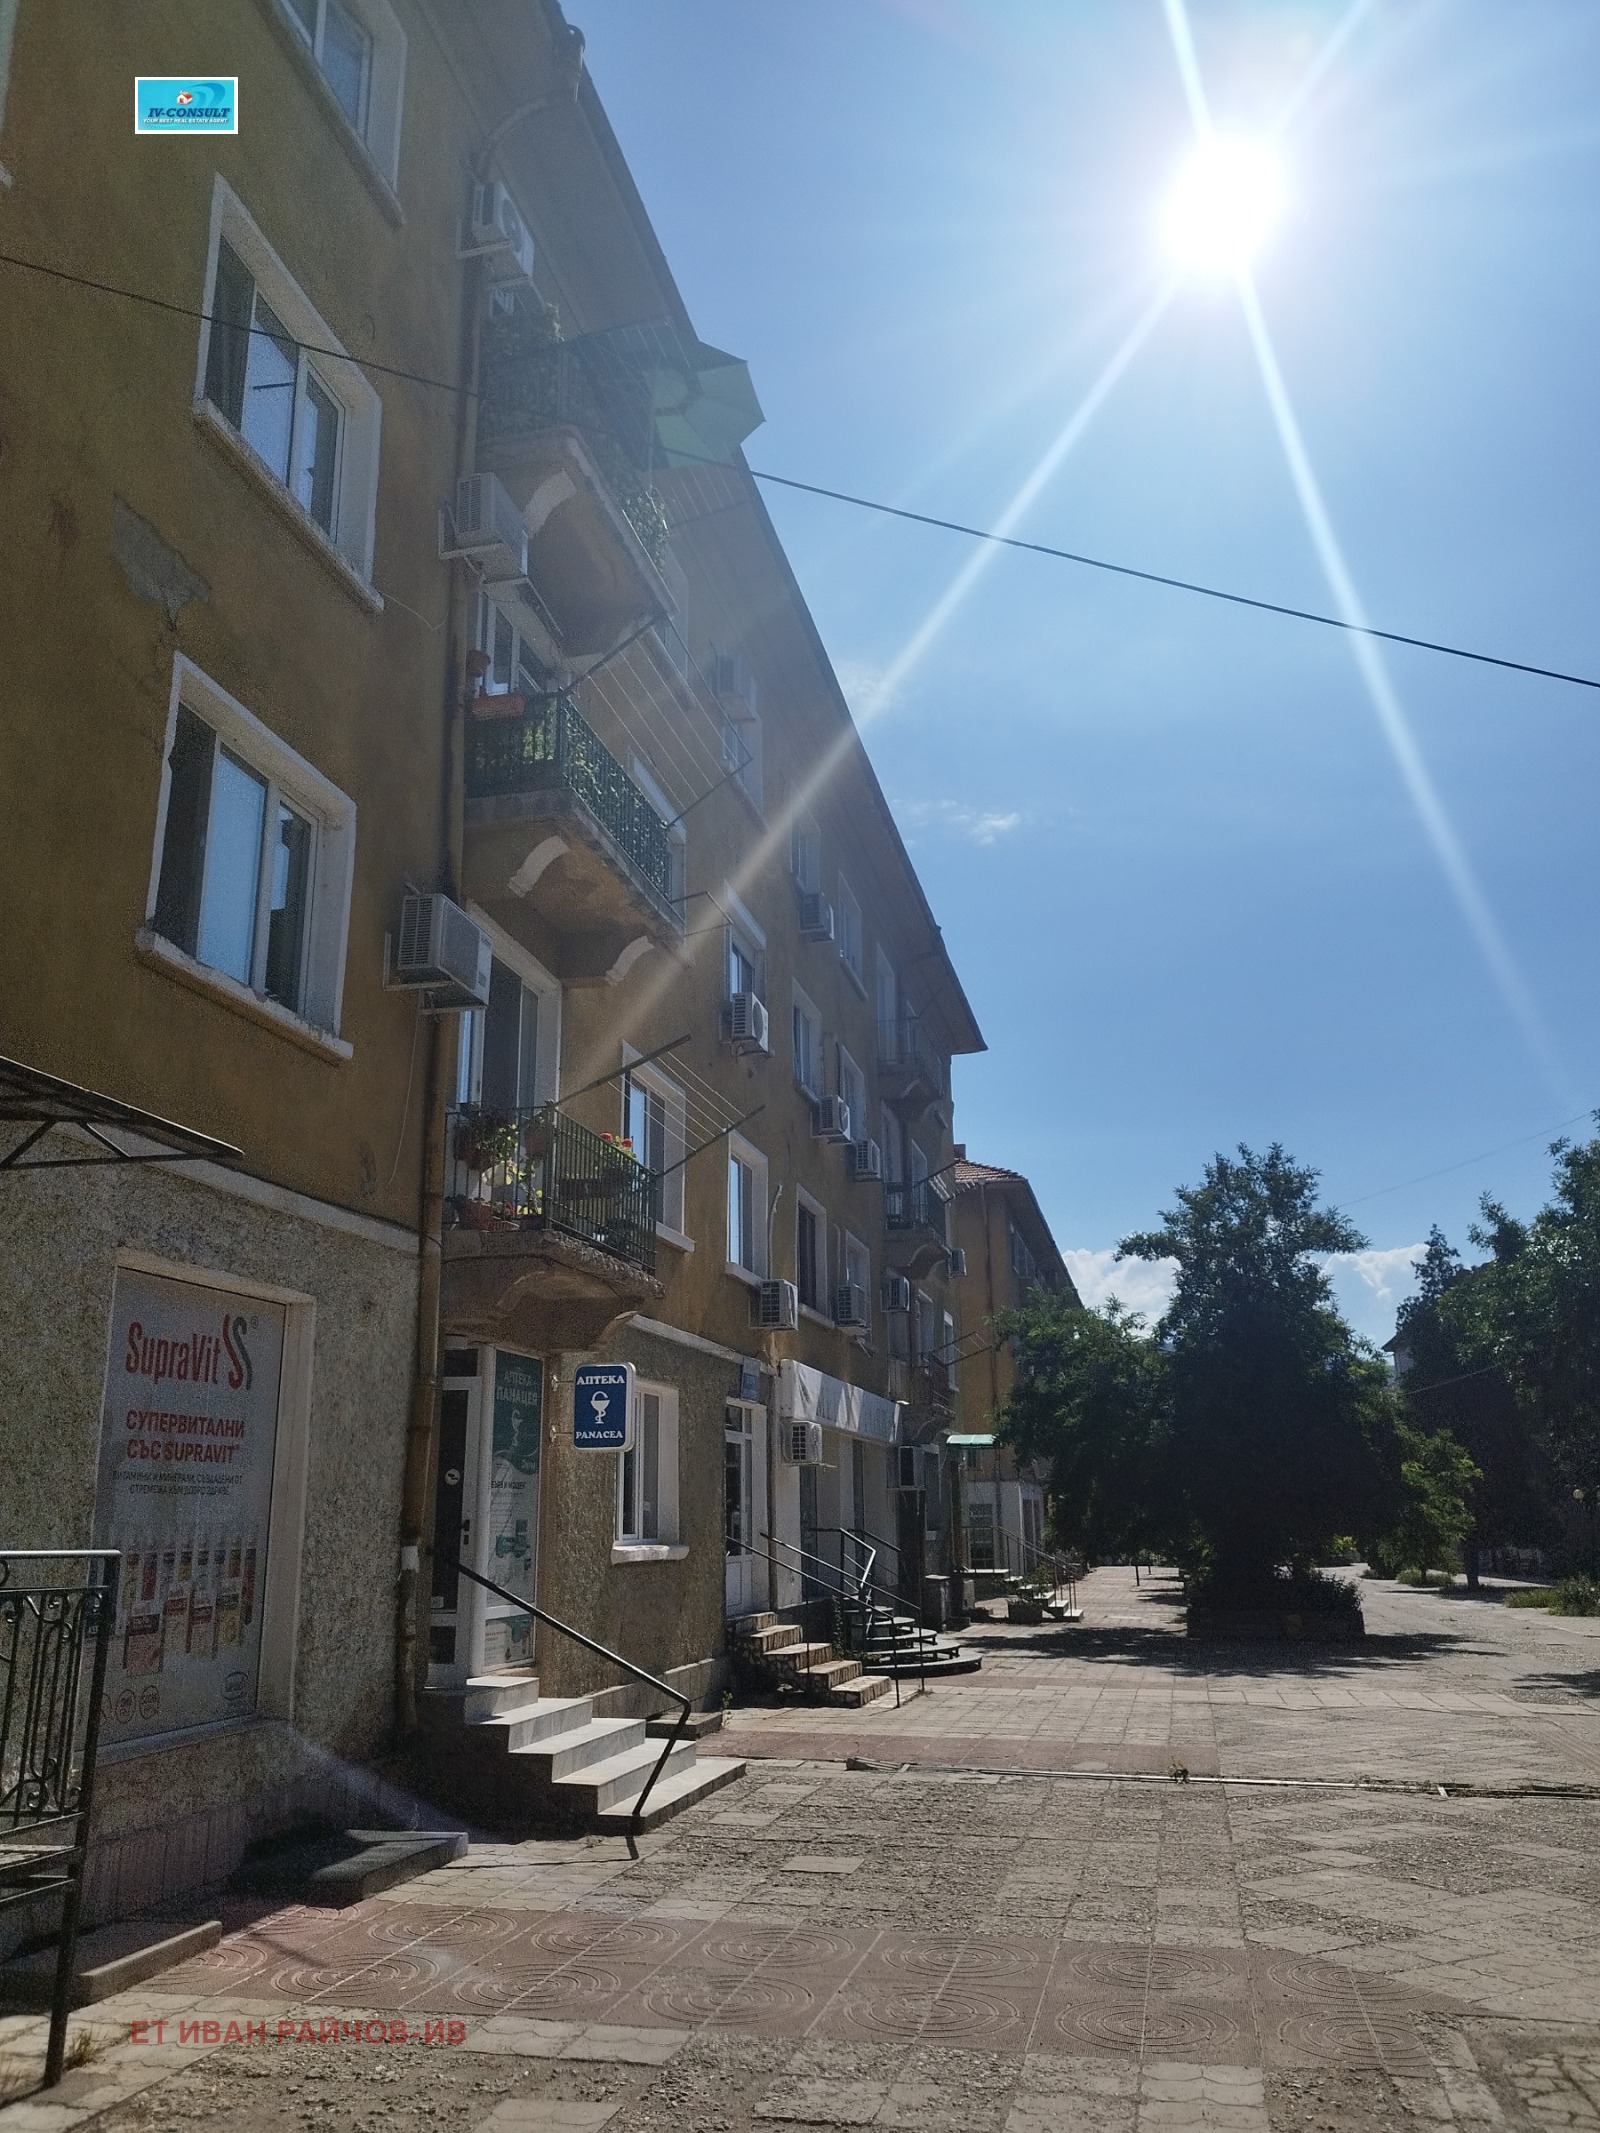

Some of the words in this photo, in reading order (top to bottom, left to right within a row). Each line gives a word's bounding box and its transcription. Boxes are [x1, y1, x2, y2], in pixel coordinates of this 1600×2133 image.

[125, 1321, 221, 1385] SupraVit
[576, 1375, 625, 1385] АПТЕКА
[126, 1409, 245, 1438] СУПЕРВИТАЛНИ
[575, 1430, 623, 1439] PANACEA
[127, 1439, 161, 1460] СЪС
